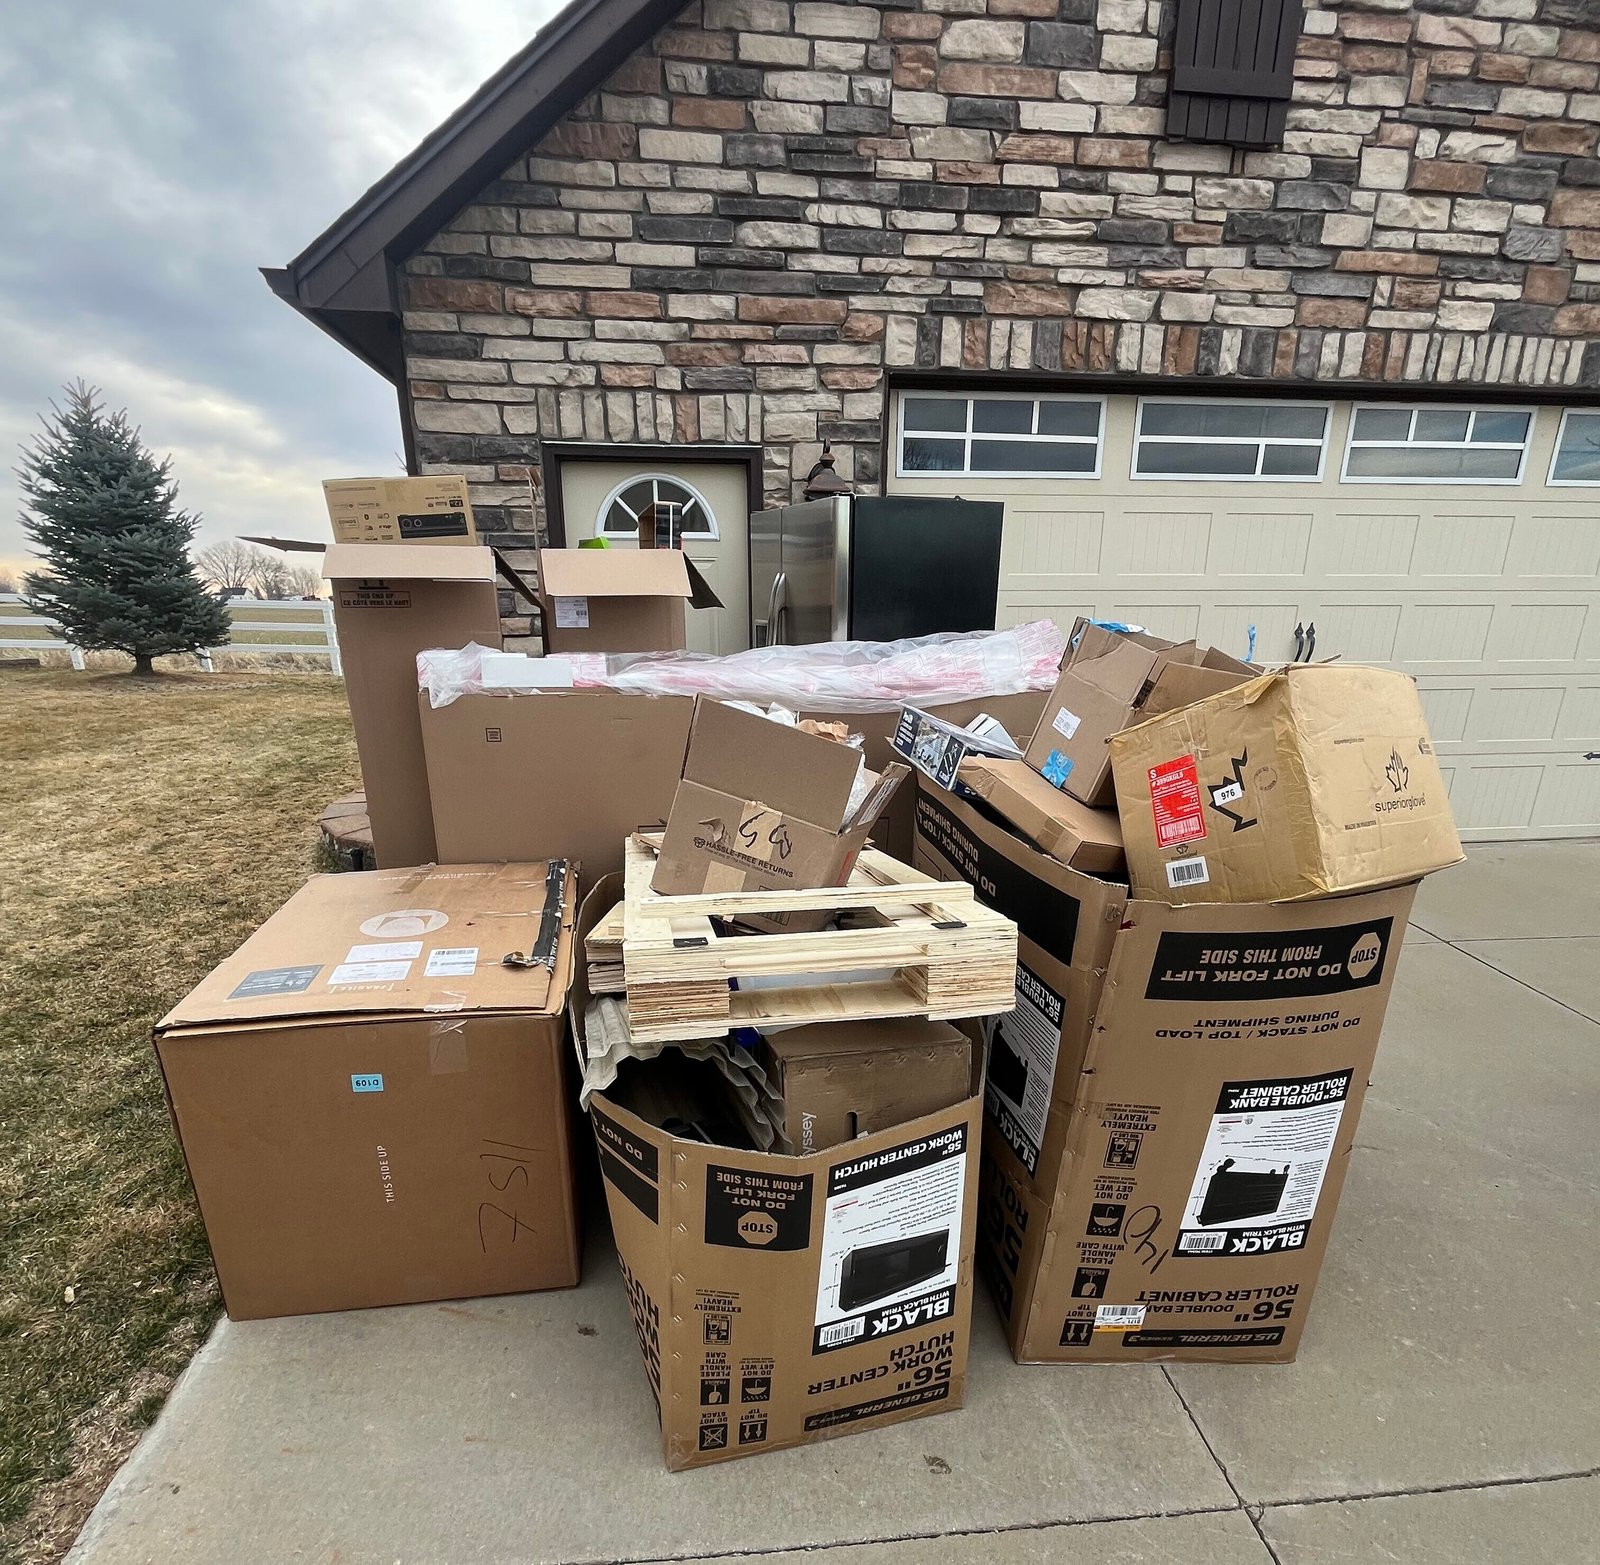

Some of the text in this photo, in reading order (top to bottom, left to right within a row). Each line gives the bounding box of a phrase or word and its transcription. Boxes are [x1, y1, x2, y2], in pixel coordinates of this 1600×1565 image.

[1150, 769, 1157, 778] S
[1221, 788, 1235, 800] 976
[919, 798, 951, 833] SHIPMENT
[923, 818, 937, 836] TOP
[941, 833, 964, 864] STACK
[952, 827, 978, 862] DURING
[706, 841, 794, 878] HASSLE-FREE RETURNS
[964, 858, 979, 882] NOT
[981, 875, 996, 897] DO
[1200, 945, 1322, 964] FROM THIS SIDE
[1350, 946, 1378, 964] STOP
[1161, 963, 1342, 982] DO NOT FORK LIFT
[1016, 975, 1045, 1008] DOUBLE
[1030, 977, 1061, 1010] ROLLER
[1194, 1011, 1340, 1028] DURING SHIPMENT
[1311, 1022, 1339, 1033] NOT
[1342, 1018, 1361, 1028] DO
[1155, 1029, 1203, 1039] LOAD
[1209, 1029, 1242, 1039] TOP
[1257, 1026, 1307, 1037] STACK
[355, 1079, 379, 1087] D109
[1240, 1076, 1347, 1098] ROLLER CABINET
[1229, 1087, 1344, 1109] 56" DOUBLE BANK
[1101, 1120, 1157, 1131] EXTREMELY
[1114, 1113, 1149, 1122] HEAVY!
[601, 1124, 643, 1160] DO NOT
[942, 1141, 962, 1156] 56"
[835, 1130, 962, 1180] WORK CENTER HUTCH
[376, 1145, 395, 1203] THIS SIDE UP
[716, 1172, 804, 1191] FROM THIS SIDE
[723, 1185, 796, 1201] FORK LIFT
[1095, 1191, 1129, 1200] DO NOT
[1115, 1184, 1134, 1192] GET
[732, 1198, 786, 1210] DO NOT
[741, 1222, 773, 1233] STOP
[1262, 1226, 1286, 1237] BLACK
[1286, 1224, 1306, 1233] WITH
[1076, 1241, 1125, 1251] WITH CARE
[1230, 1231, 1304, 1253] BLACK
[1080, 1249, 1116, 1258] HANDLE
[1080, 1256, 1114, 1265] PLEASE
[703, 1297, 732, 1306] HEAVY!
[1134, 1284, 1300, 1302] ROLLER CABINET
[694, 1304, 741, 1313] EXTREMELY
[881, 1290, 950, 1317] WITH BLACK TRIM
[1146, 1299, 1294, 1323] 56" DOUBLE BAN
[872, 1297, 950, 1336] BLACK
[890, 1330, 954, 1361] HUTCH
[1180, 1333, 1252, 1343] GENERAL
[808, 1345, 953, 1395] WORK CENTER
[898, 1359, 952, 1392] 56"
[856, 1393, 921, 1415] GENERAL
